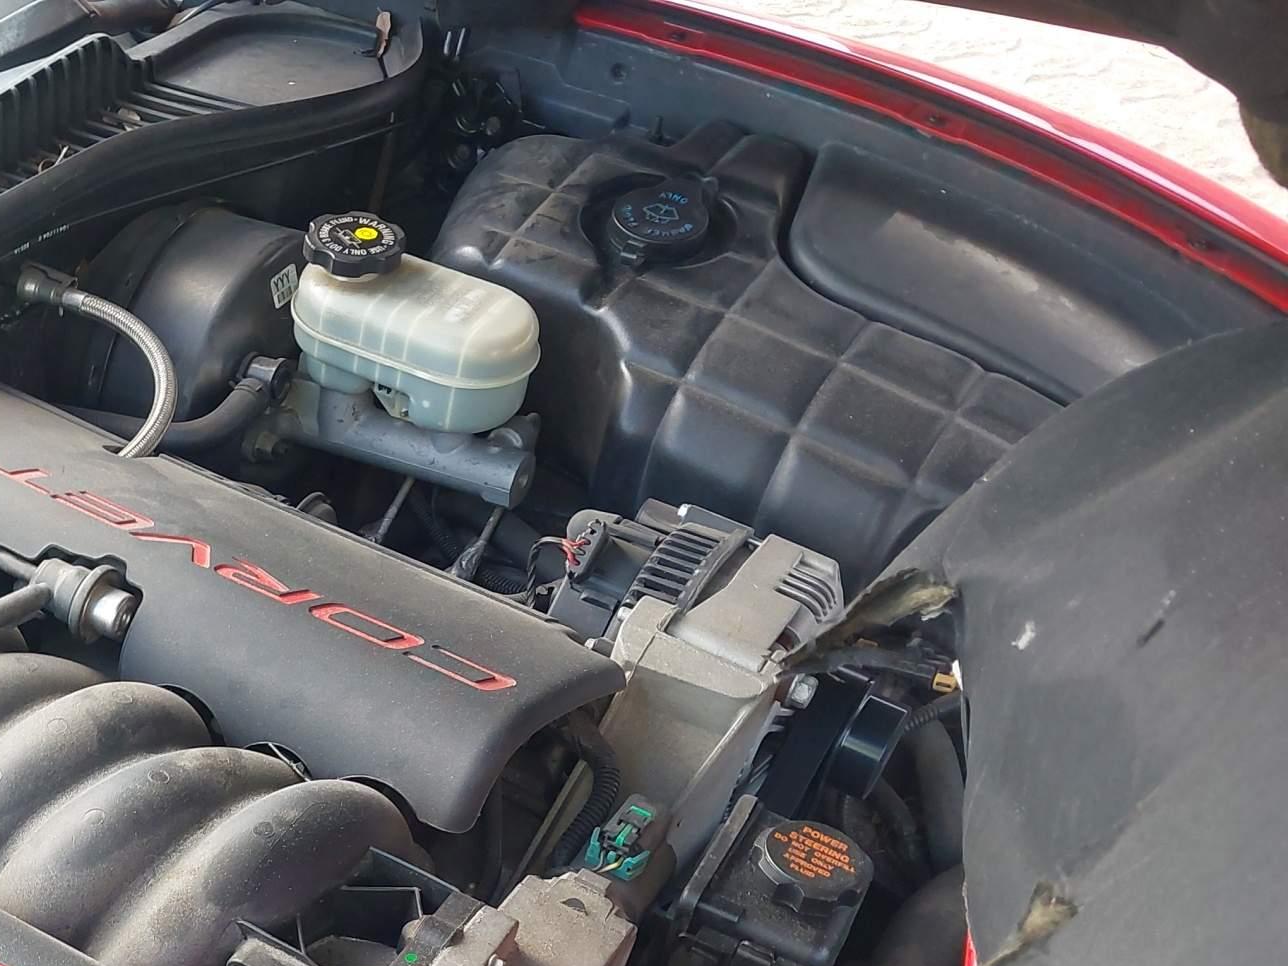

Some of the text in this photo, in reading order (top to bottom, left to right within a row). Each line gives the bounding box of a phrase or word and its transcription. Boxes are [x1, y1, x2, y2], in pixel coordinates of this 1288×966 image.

[658, 192, 688, 205] ONLY
[359, 217, 395, 245] WARNING
[325, 242, 343, 252] DOT
[343, 248, 367, 256] ONLY
[368, 245, 386, 254] USE
[273, 269, 290, 292] YYY
[788, 831, 850, 865] STEERING
[802, 825, 849, 852] POWER
[774, 832, 856, 874] DO NOT OVERFILL
[783, 852, 831, 878] APPROVED
[790, 862, 816, 879] FLUID
[810, 857, 835, 871] ONLY
